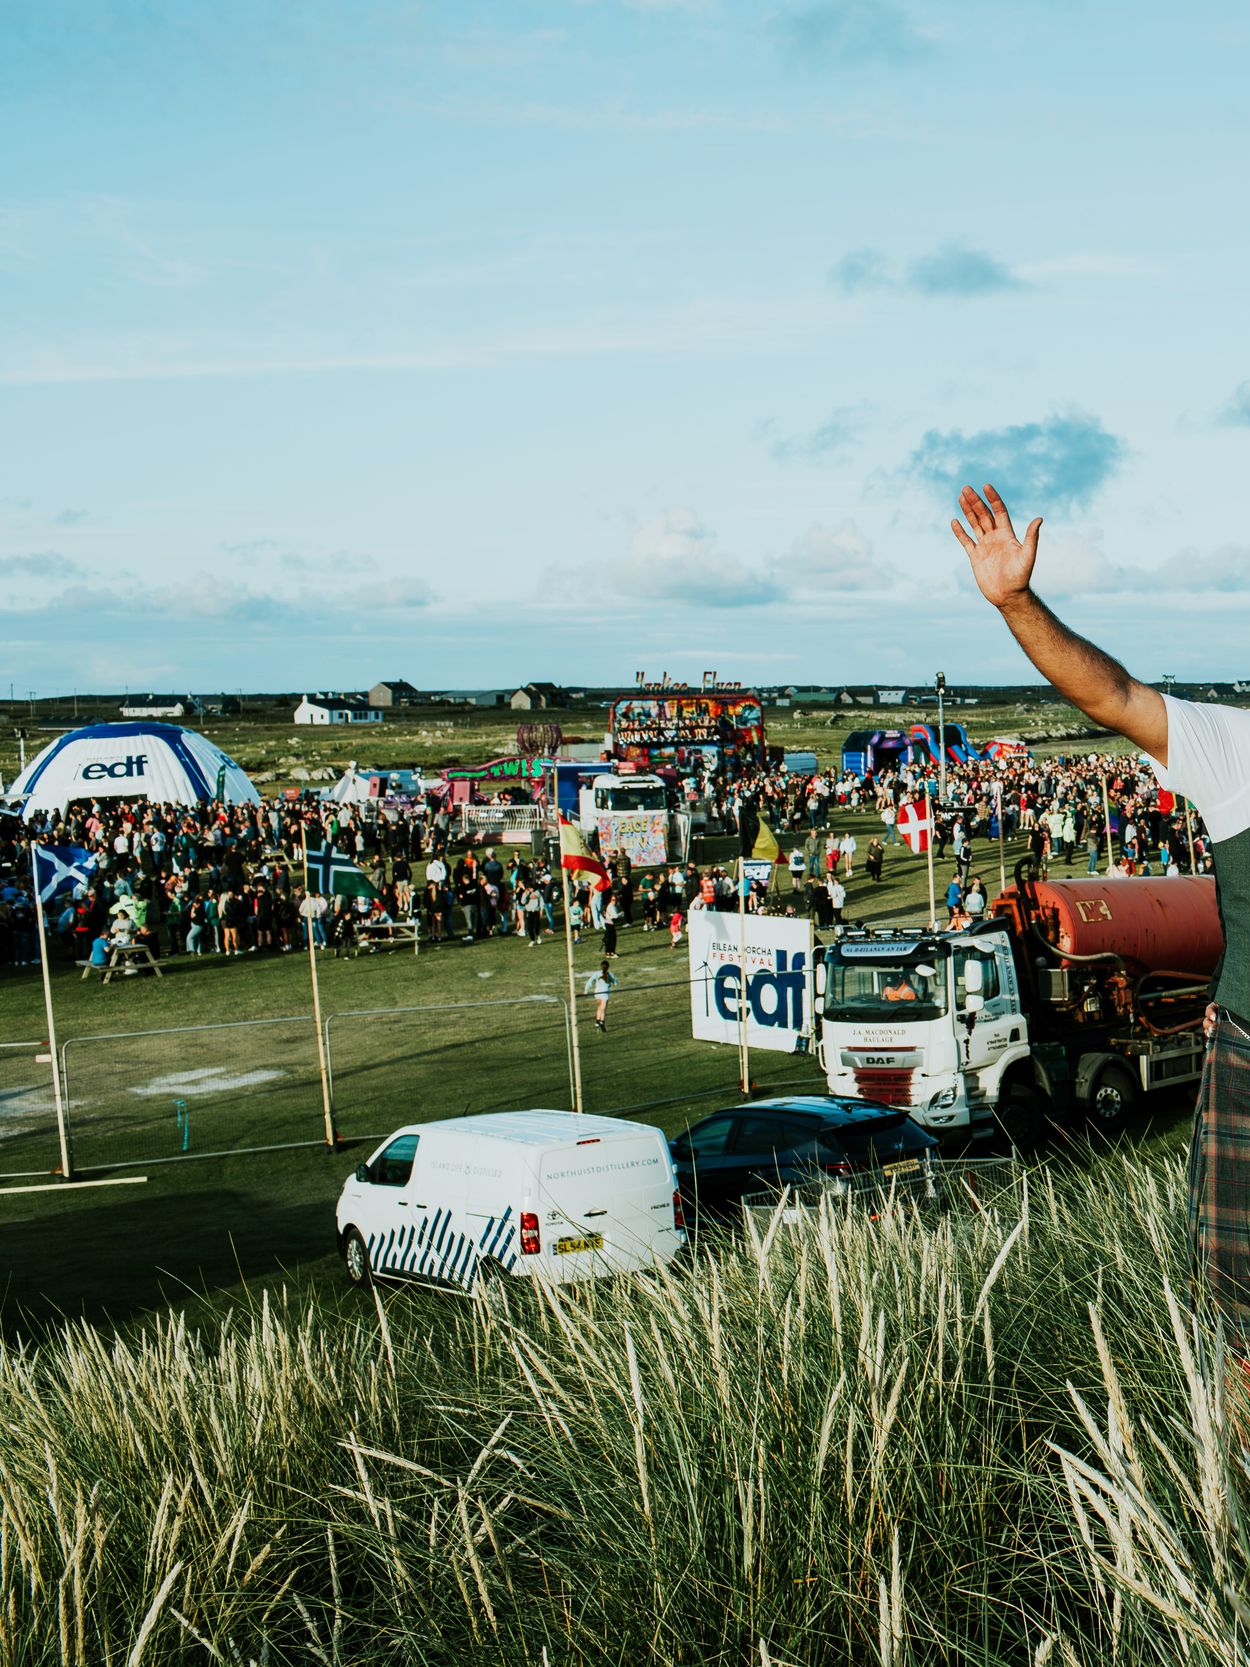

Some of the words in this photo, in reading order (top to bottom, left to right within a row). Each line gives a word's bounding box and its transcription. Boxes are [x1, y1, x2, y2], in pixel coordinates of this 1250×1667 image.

[82, 754, 148, 780] edf
[712, 942, 738, 952] EILEAN
[742, 945, 772, 956] ORCHA
[712, 952, 773, 967] FESTIVAL
[714, 949, 806, 1031] edf
[866, 1057, 895, 1065] DAF
[547, 1157, 660, 1180] NORTHUISTDISTILLERY.COM
